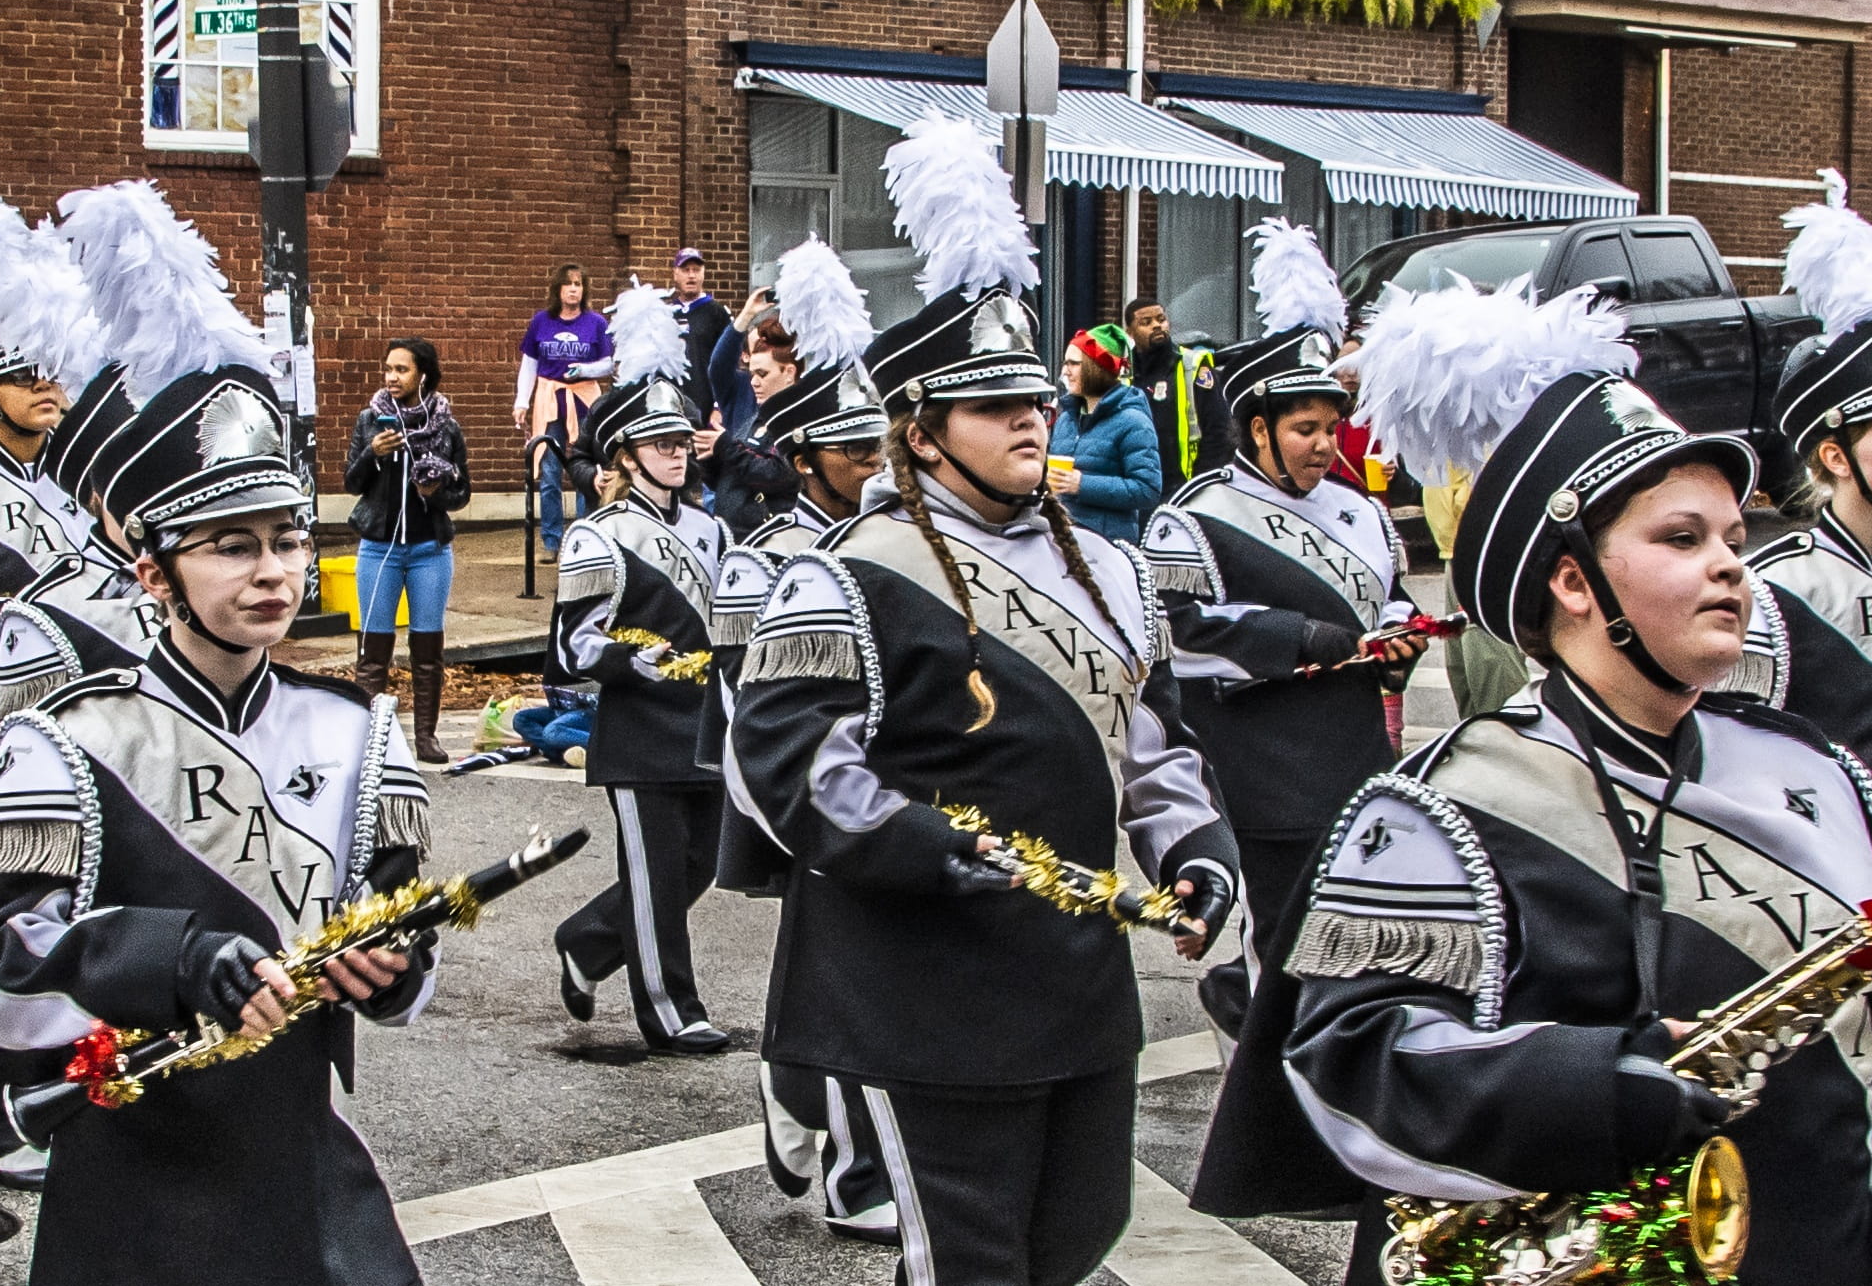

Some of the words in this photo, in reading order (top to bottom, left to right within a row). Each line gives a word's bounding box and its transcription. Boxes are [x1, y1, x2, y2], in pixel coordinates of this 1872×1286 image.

[201, 13, 214, 34] W.
[217, 12, 245, 34] 36TH
[539, 341, 591, 357] TEAM
[954, 561, 1135, 738] RAVEN
